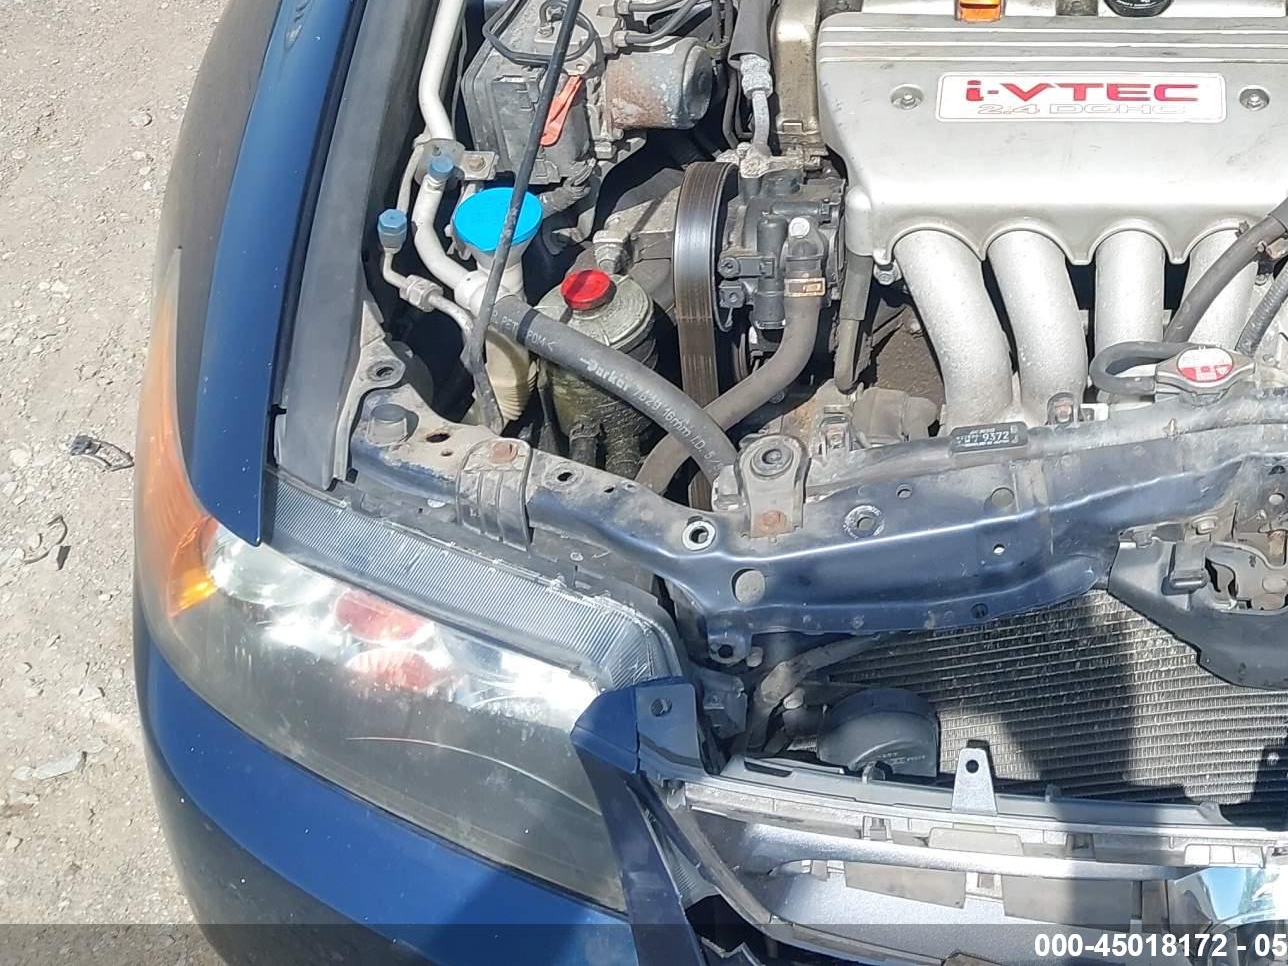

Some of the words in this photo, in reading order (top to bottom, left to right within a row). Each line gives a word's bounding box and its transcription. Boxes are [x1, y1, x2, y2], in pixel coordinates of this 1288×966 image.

[965, 79, 1199, 102] i-VTEC
[977, 103, 1041, 115] 2.4
[1049, 103, 1186, 115] DOHC
